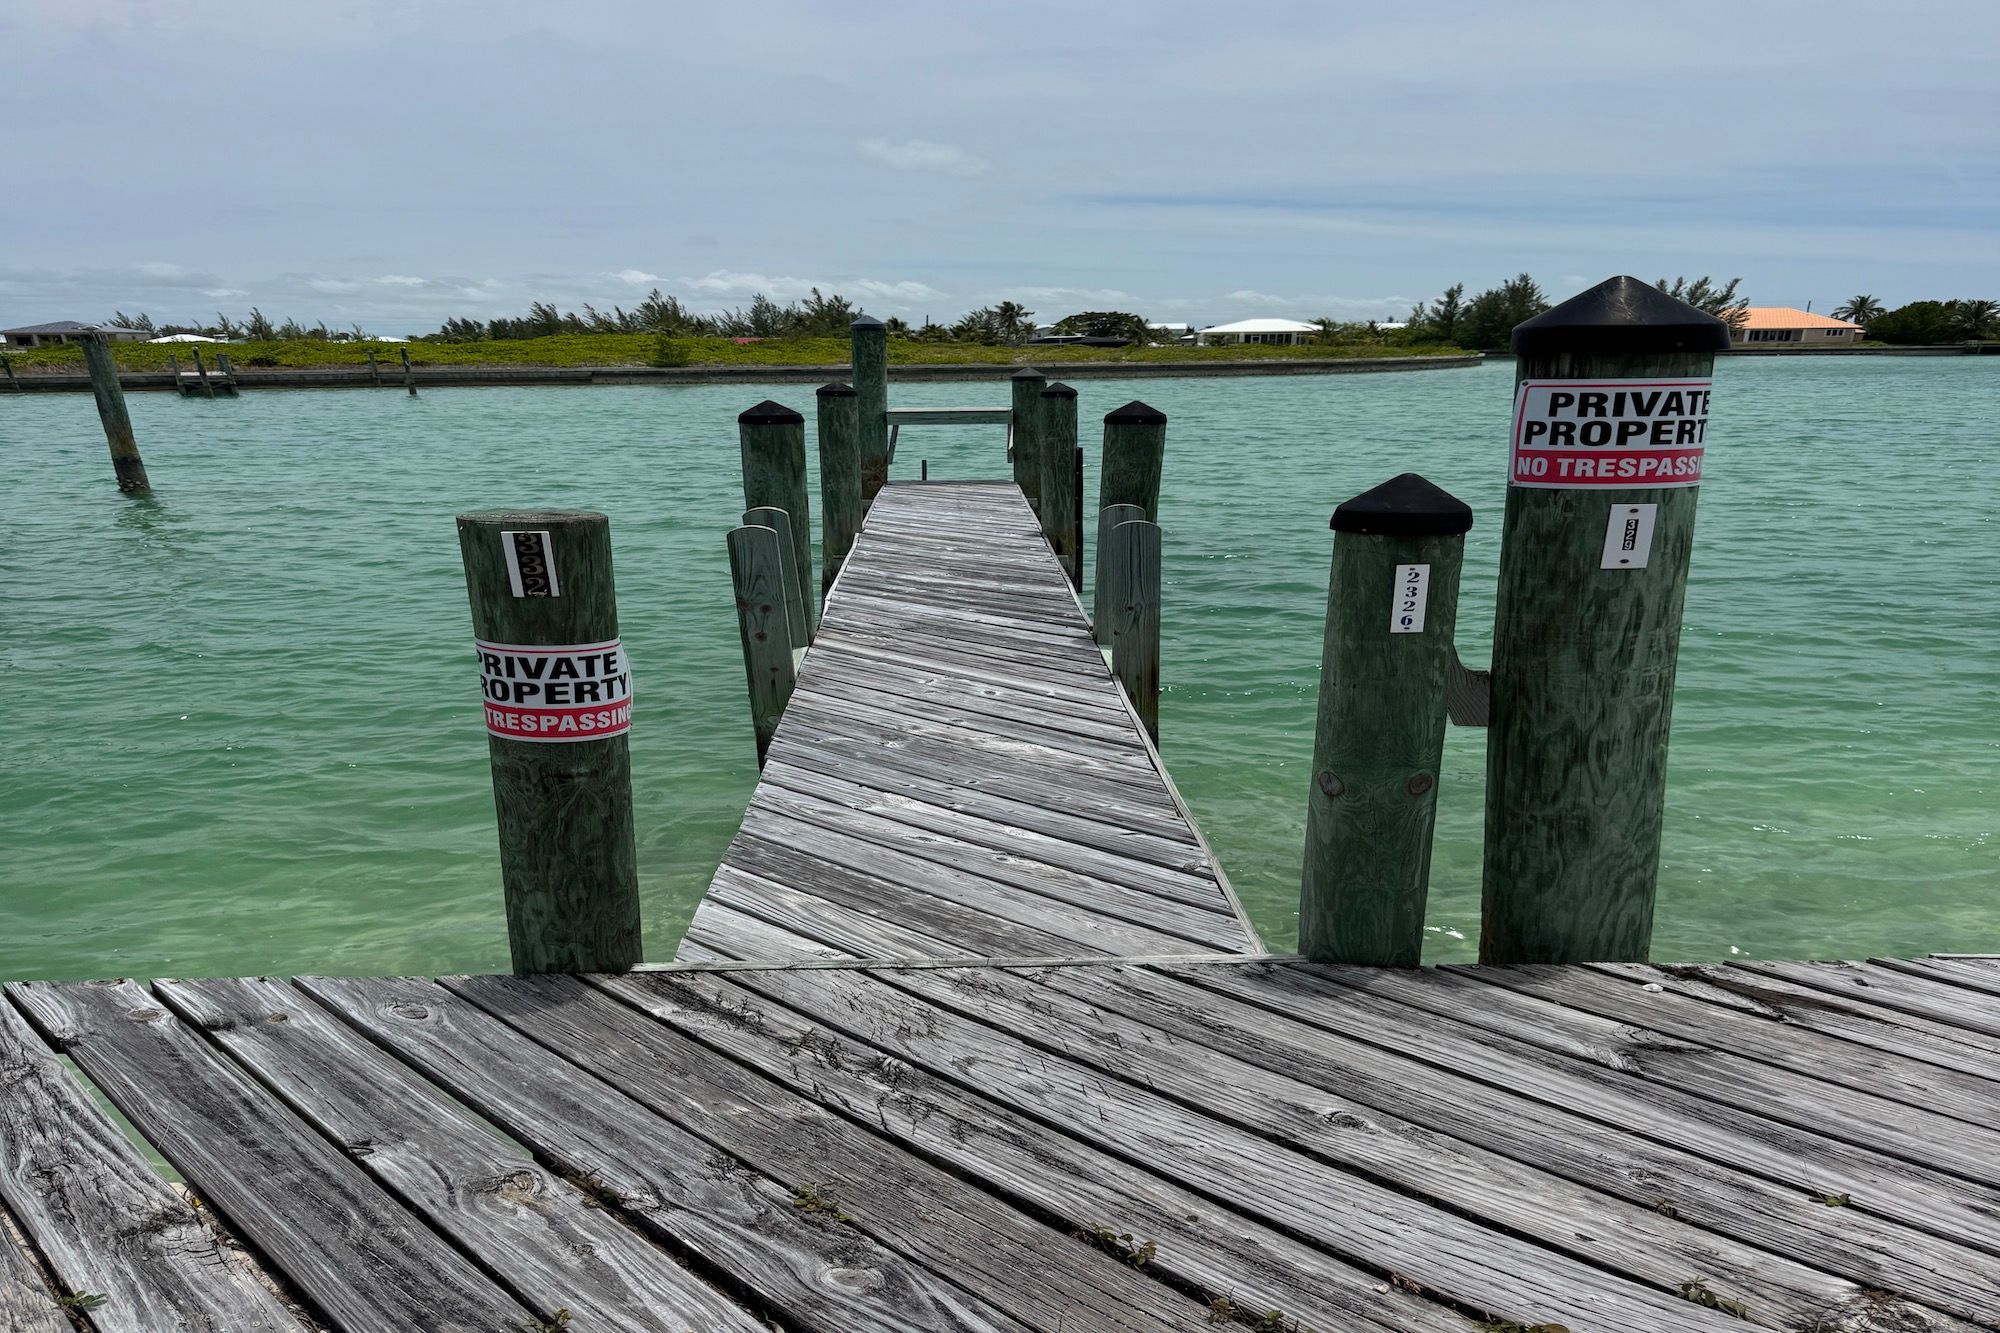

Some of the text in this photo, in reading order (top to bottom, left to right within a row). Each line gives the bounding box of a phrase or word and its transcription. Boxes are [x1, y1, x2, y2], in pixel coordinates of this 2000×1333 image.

[1548, 390, 1711, 417] PRIVATE
[1523, 419, 1707, 446] PROPERT
[1516, 455, 1702, 478] NO TRESPASSI
[1623, 519, 1637, 550] 329
[1400, 571, 1421, 626] 2326
[479, 672, 627, 705] ROPERTY
